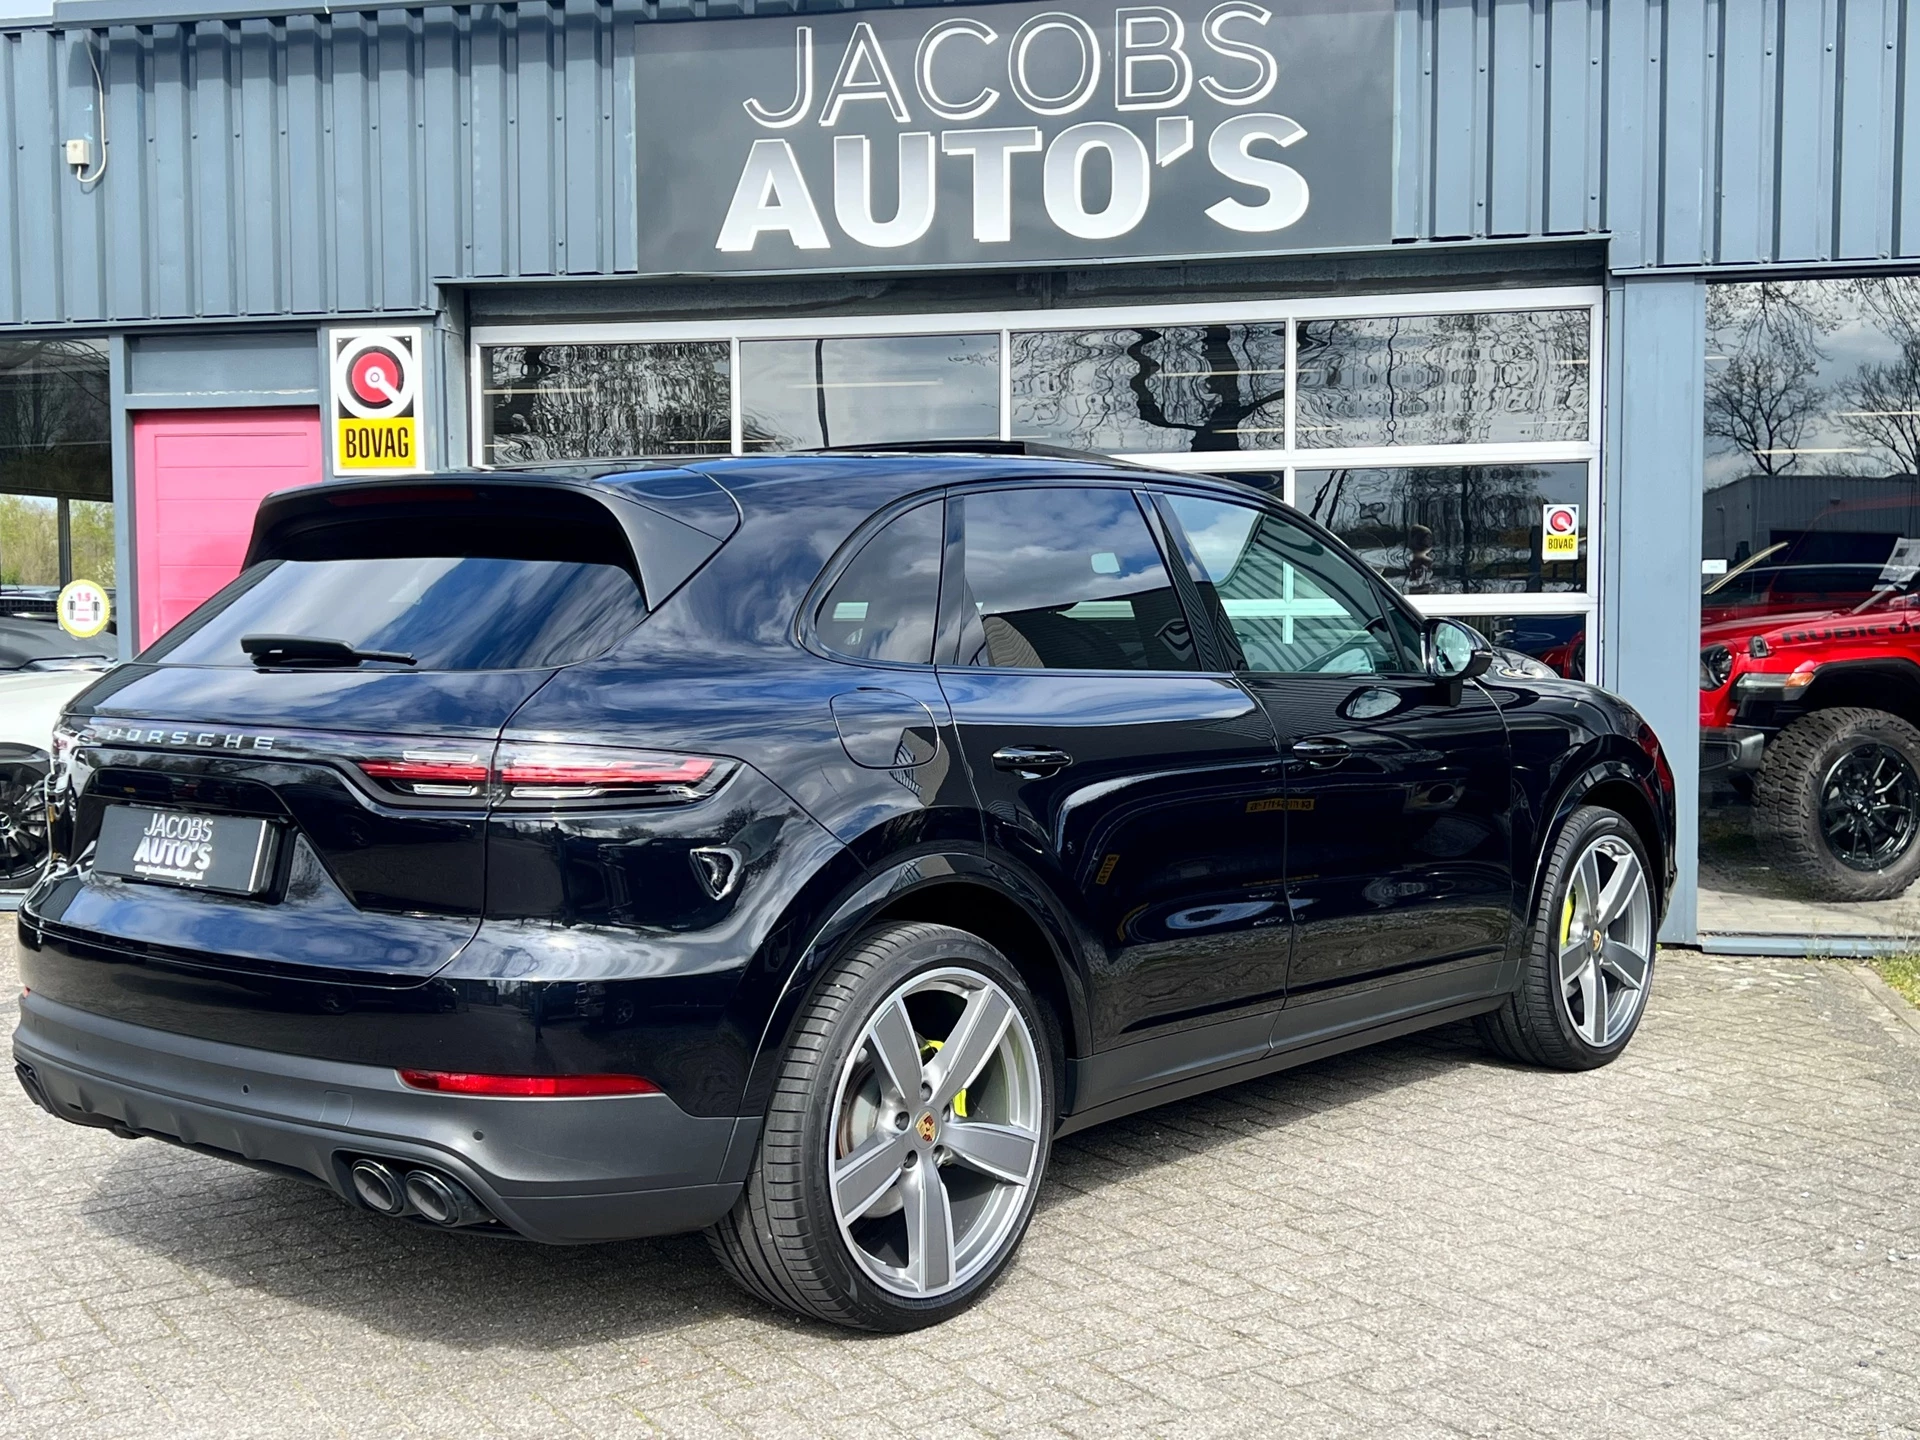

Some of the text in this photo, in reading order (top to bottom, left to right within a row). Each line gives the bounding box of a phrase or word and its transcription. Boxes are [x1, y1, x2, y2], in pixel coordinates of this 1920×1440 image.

[743, 1, 1278, 127] JACOBS
[715, 113, 1309, 251] AUTO'S
[346, 426, 409, 458] BOVAG
[1548, 538, 1574, 550] BOVAG
[144, 813, 214, 842] JACOBS
[133, 837, 213, 870] AUTO'S
